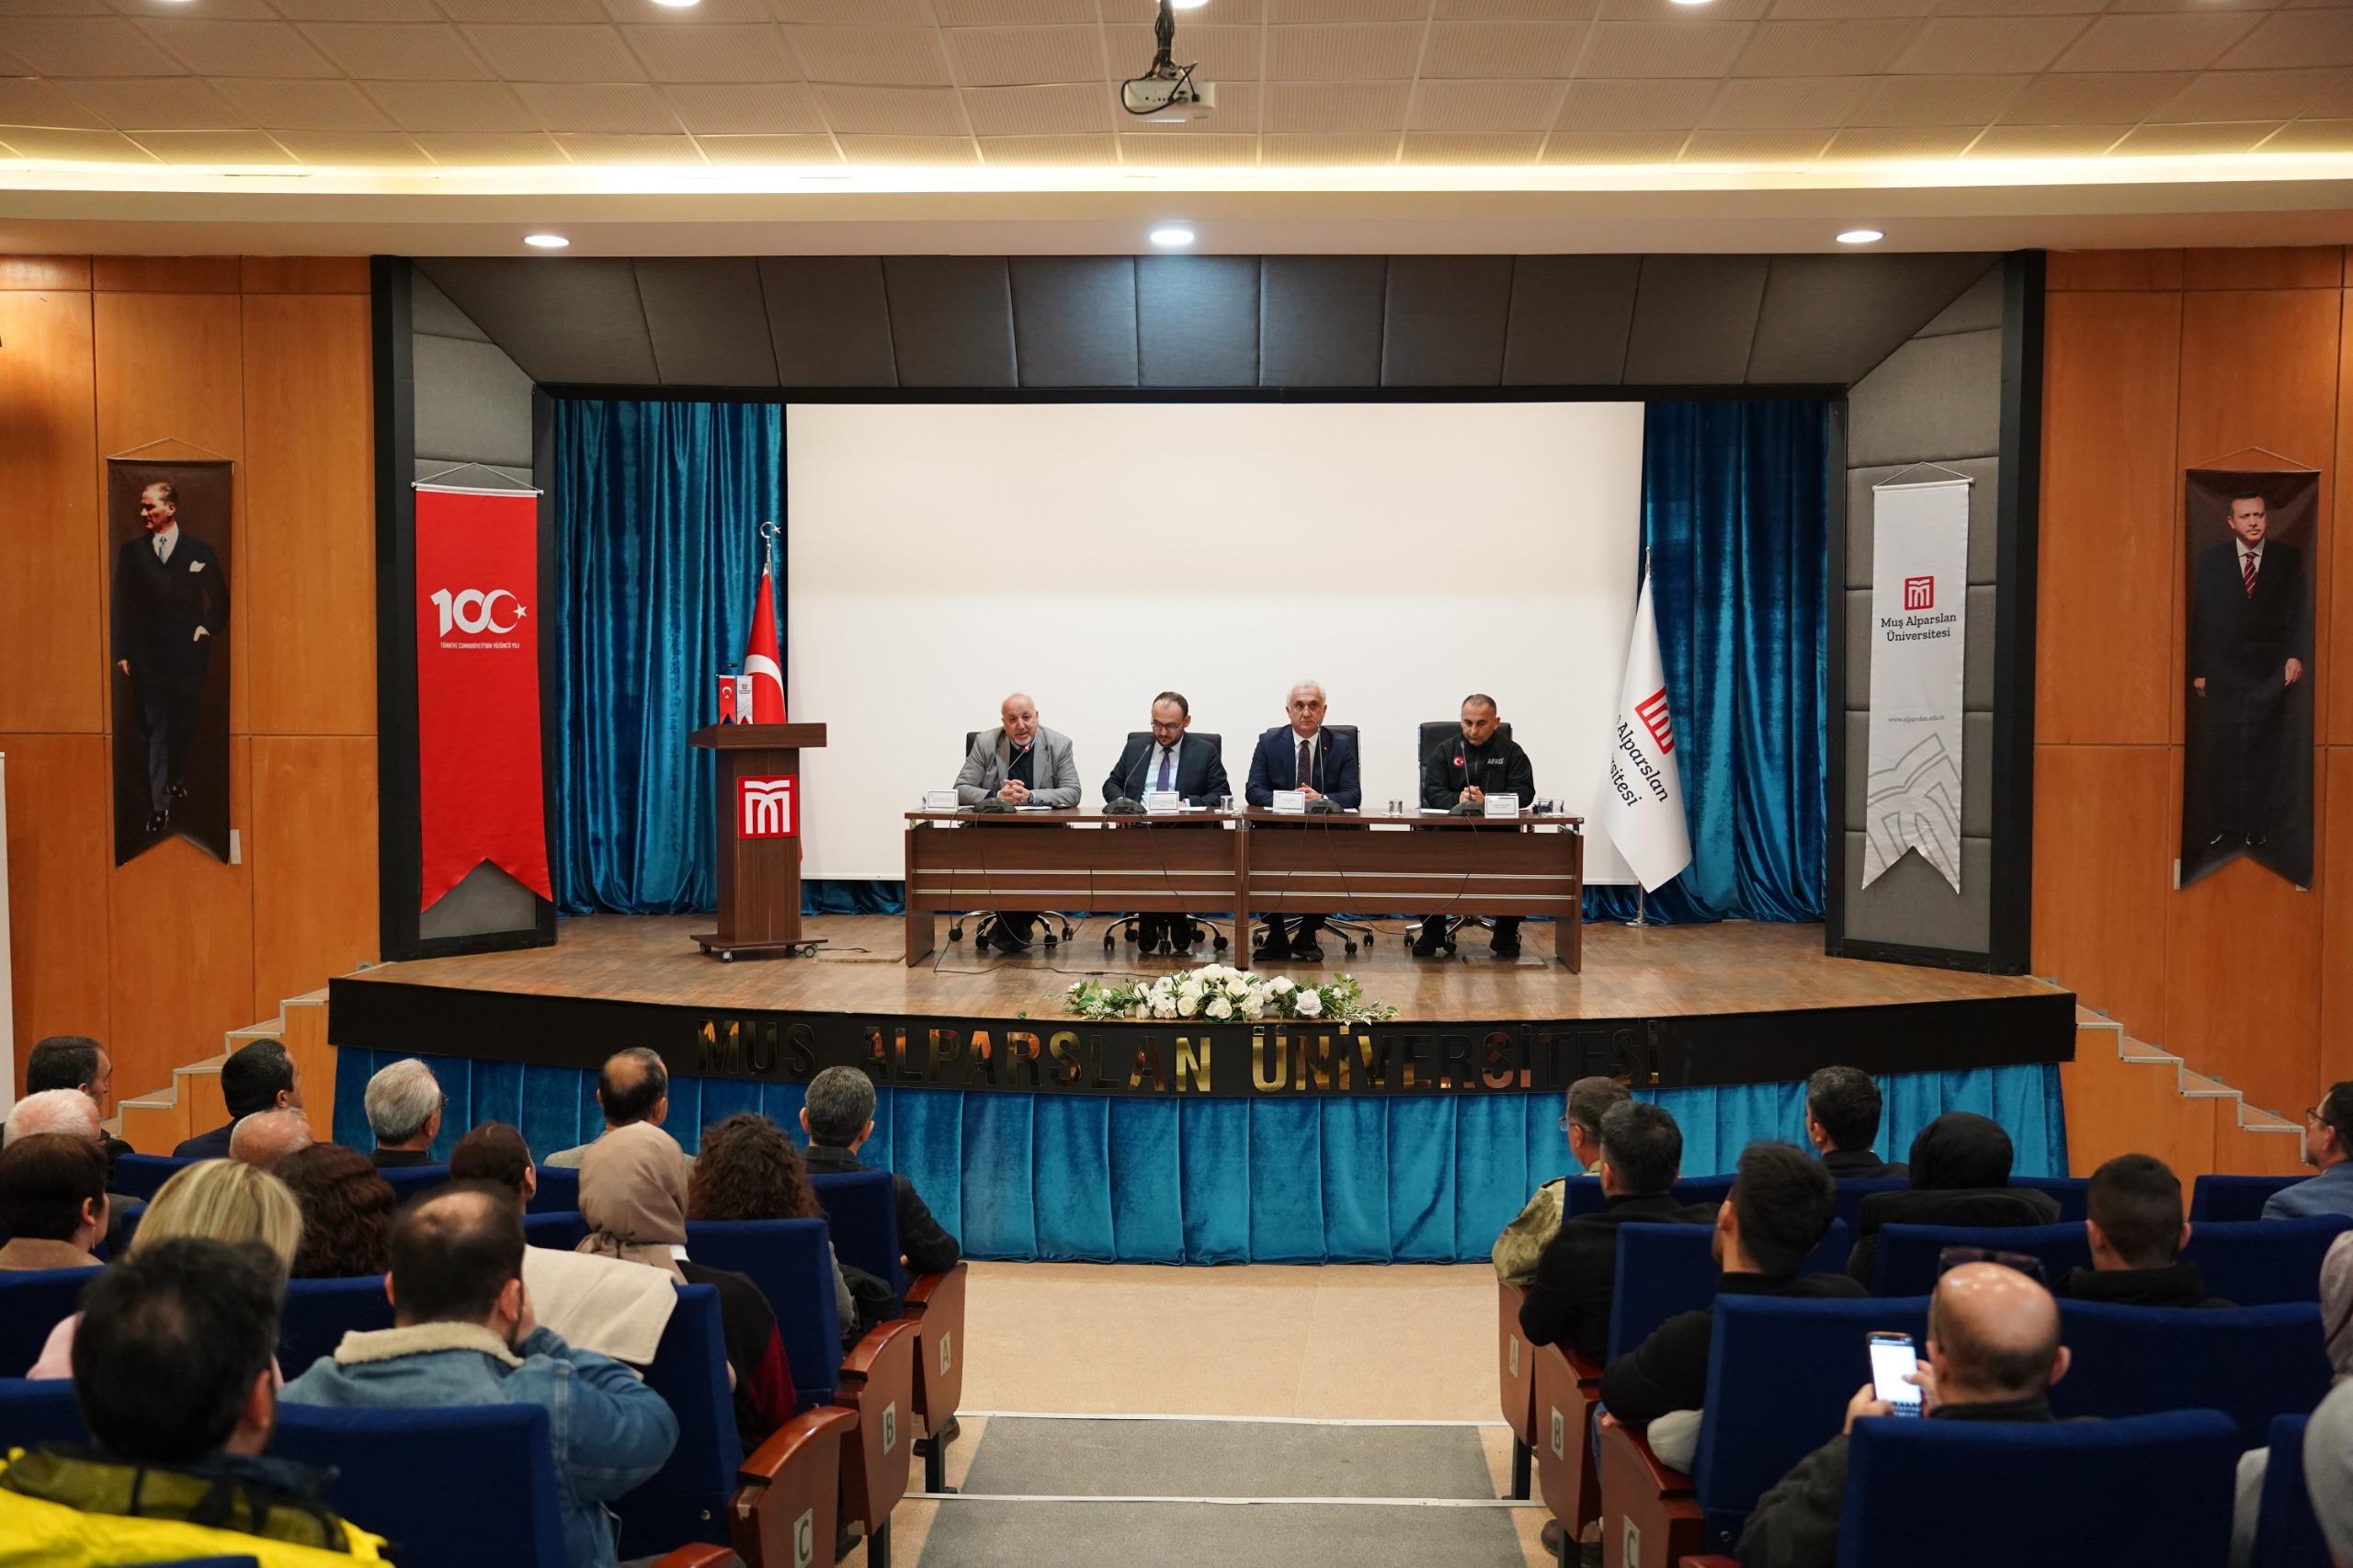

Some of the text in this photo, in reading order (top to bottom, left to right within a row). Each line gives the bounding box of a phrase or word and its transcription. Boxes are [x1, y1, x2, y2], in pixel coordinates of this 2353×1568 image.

[1881, 612, 1957, 630] Muş Alparslan
[1886, 627, 1951, 642] Üniversitesi
[1617, 722, 1668, 802] Alparslan
[857, 1025, 1212, 1093] ALPARSLAN
[886, 1412, 893, 1445] B
[1554, 1417, 1561, 1450] B
[800, 1519, 809, 1562] C
